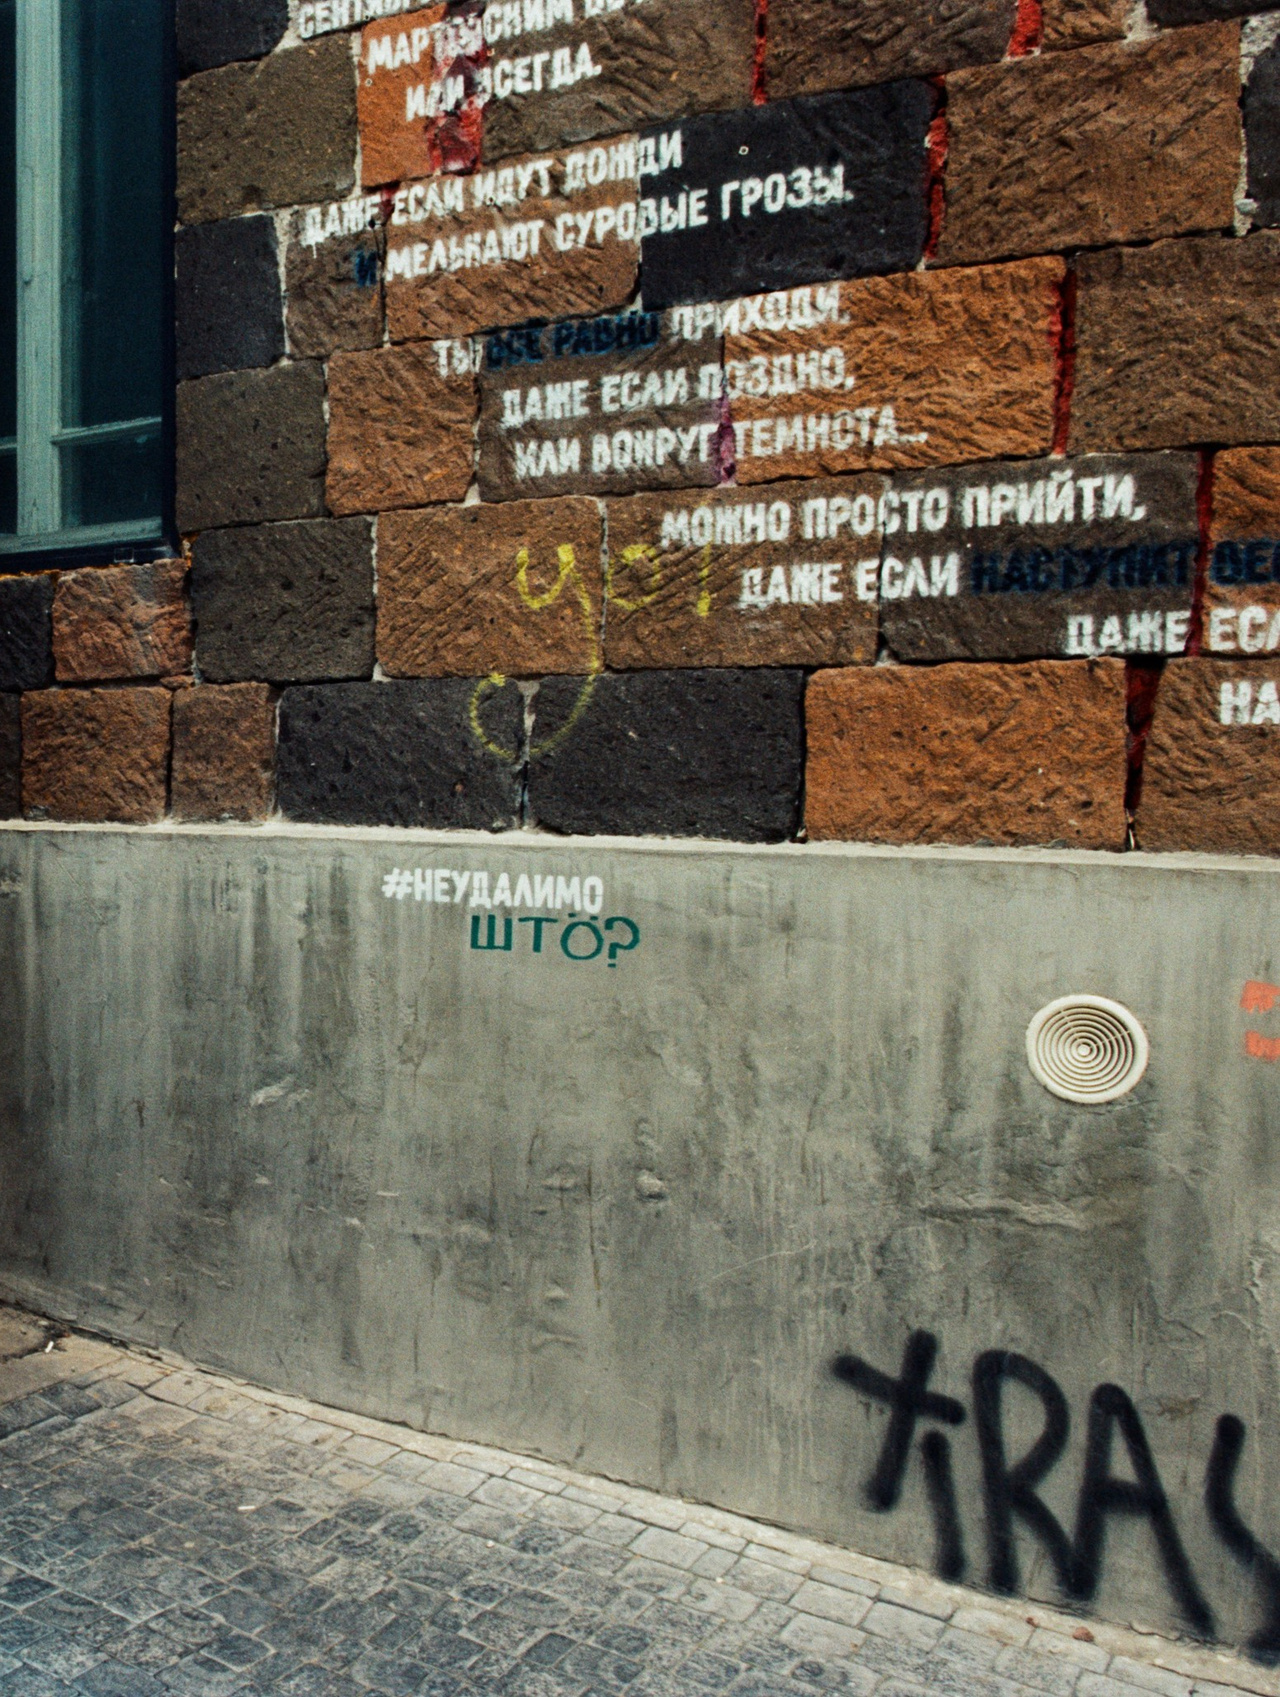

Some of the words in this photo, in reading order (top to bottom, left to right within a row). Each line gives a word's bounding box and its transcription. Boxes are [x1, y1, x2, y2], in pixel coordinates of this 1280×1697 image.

[405, 75, 464, 122] ИЛИ
[302, 195, 381, 250] ДАЖЕ
[391, 175, 465, 226] ЕСЛИ
[473, 159, 553, 210] ИДУТ
[563, 130, 683, 188] ДОЖДИ
[555, 188, 709, 253] СУРОВЫЕ
[720, 164, 855, 221] ГРОЗЫ.
[669, 288, 851, 342] ПРИХОДИ.
[501, 378, 591, 428] ДАЖЕ
[601, 366, 687, 412] ЕСЛИ
[698, 346, 855, 400] ПОЗДНО,
[513, 437, 581, 479] ИЛИ
[592, 423, 720, 471] ВОКРУГ
[660, 501, 790, 548] МОЖНО
[801, 491, 949, 540] ПРОСТО
[961, 469, 1147, 529] ПРИЙТИ,
[739, 563, 844, 608] ДАЖЕ
[856, 553, 961, 602] ЕСЛИ
[1065, 610, 1191, 656] ДАЖЕ
[381, 867, 604, 914] #НЕУДАЛИМО
